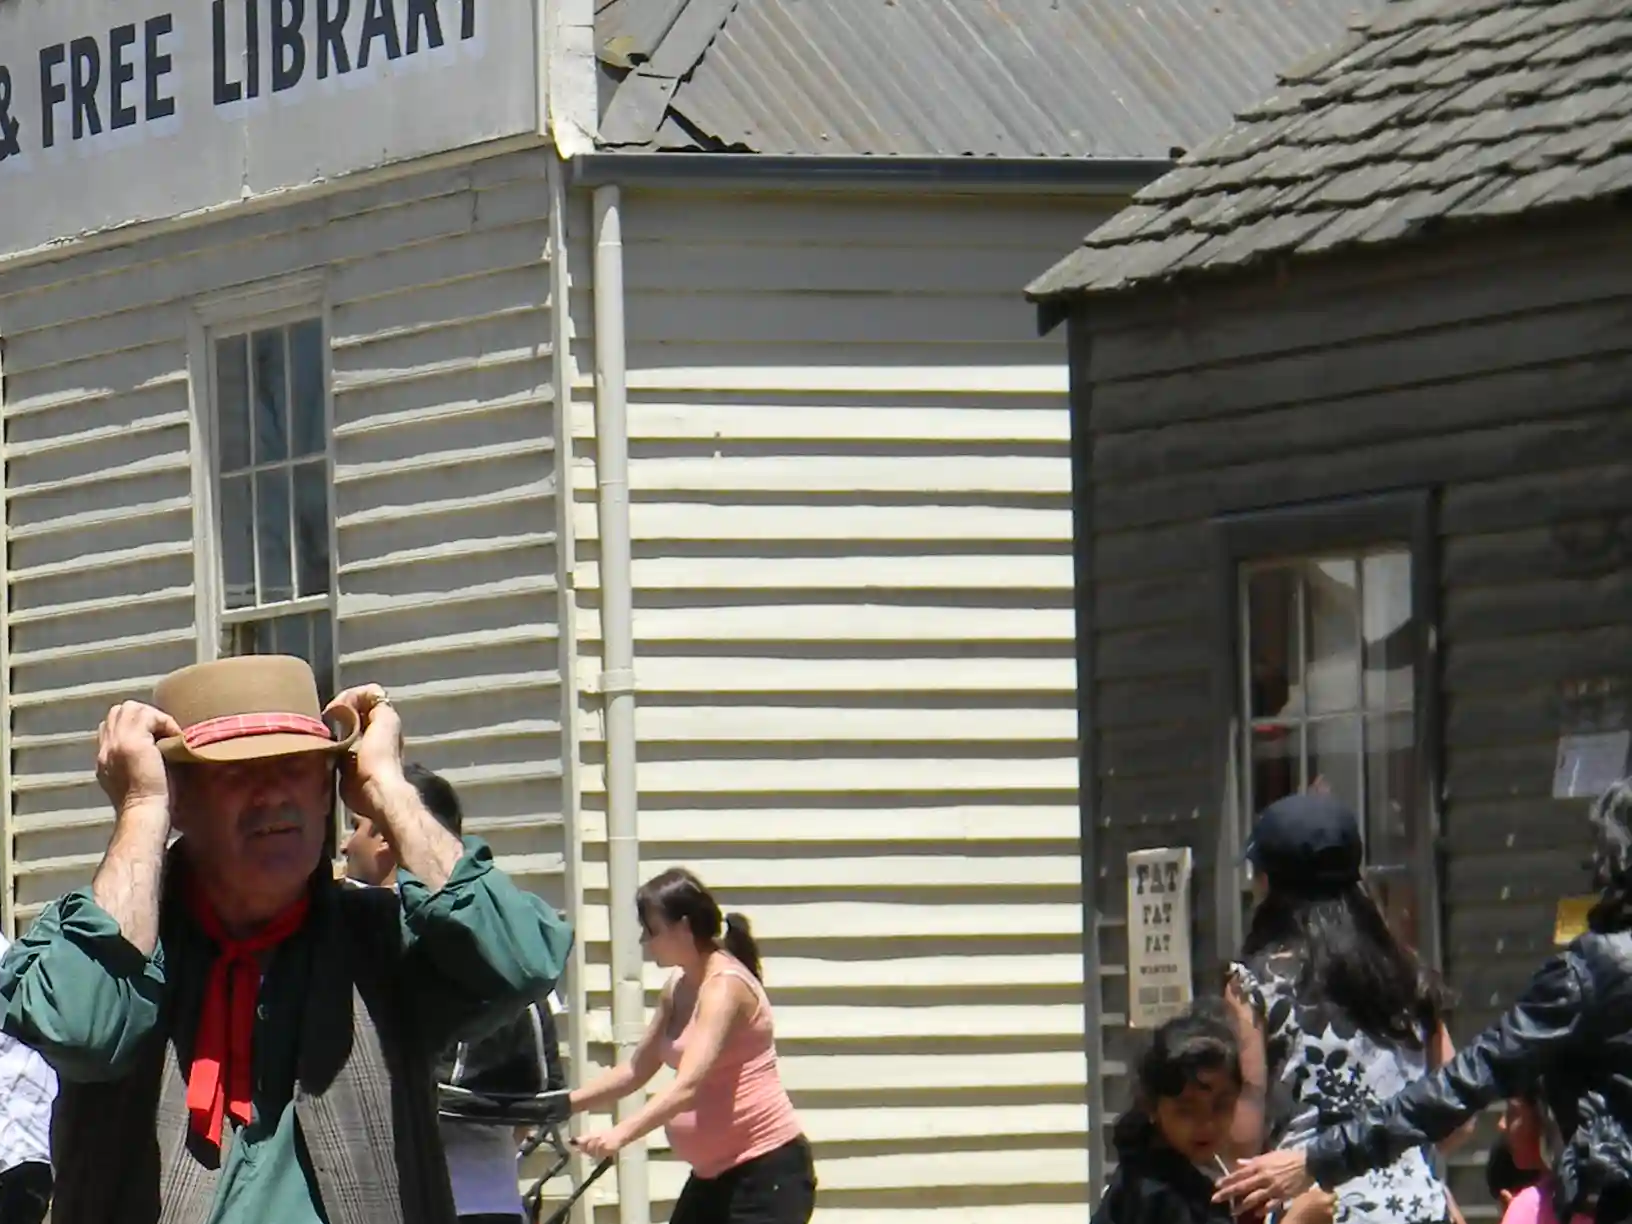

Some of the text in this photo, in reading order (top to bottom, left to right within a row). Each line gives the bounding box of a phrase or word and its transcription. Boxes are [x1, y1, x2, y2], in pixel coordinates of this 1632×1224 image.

[38, 13, 175, 149] FREE
[1136, 861, 1179, 895] FAT
[1143, 903, 1172, 925] FAT
